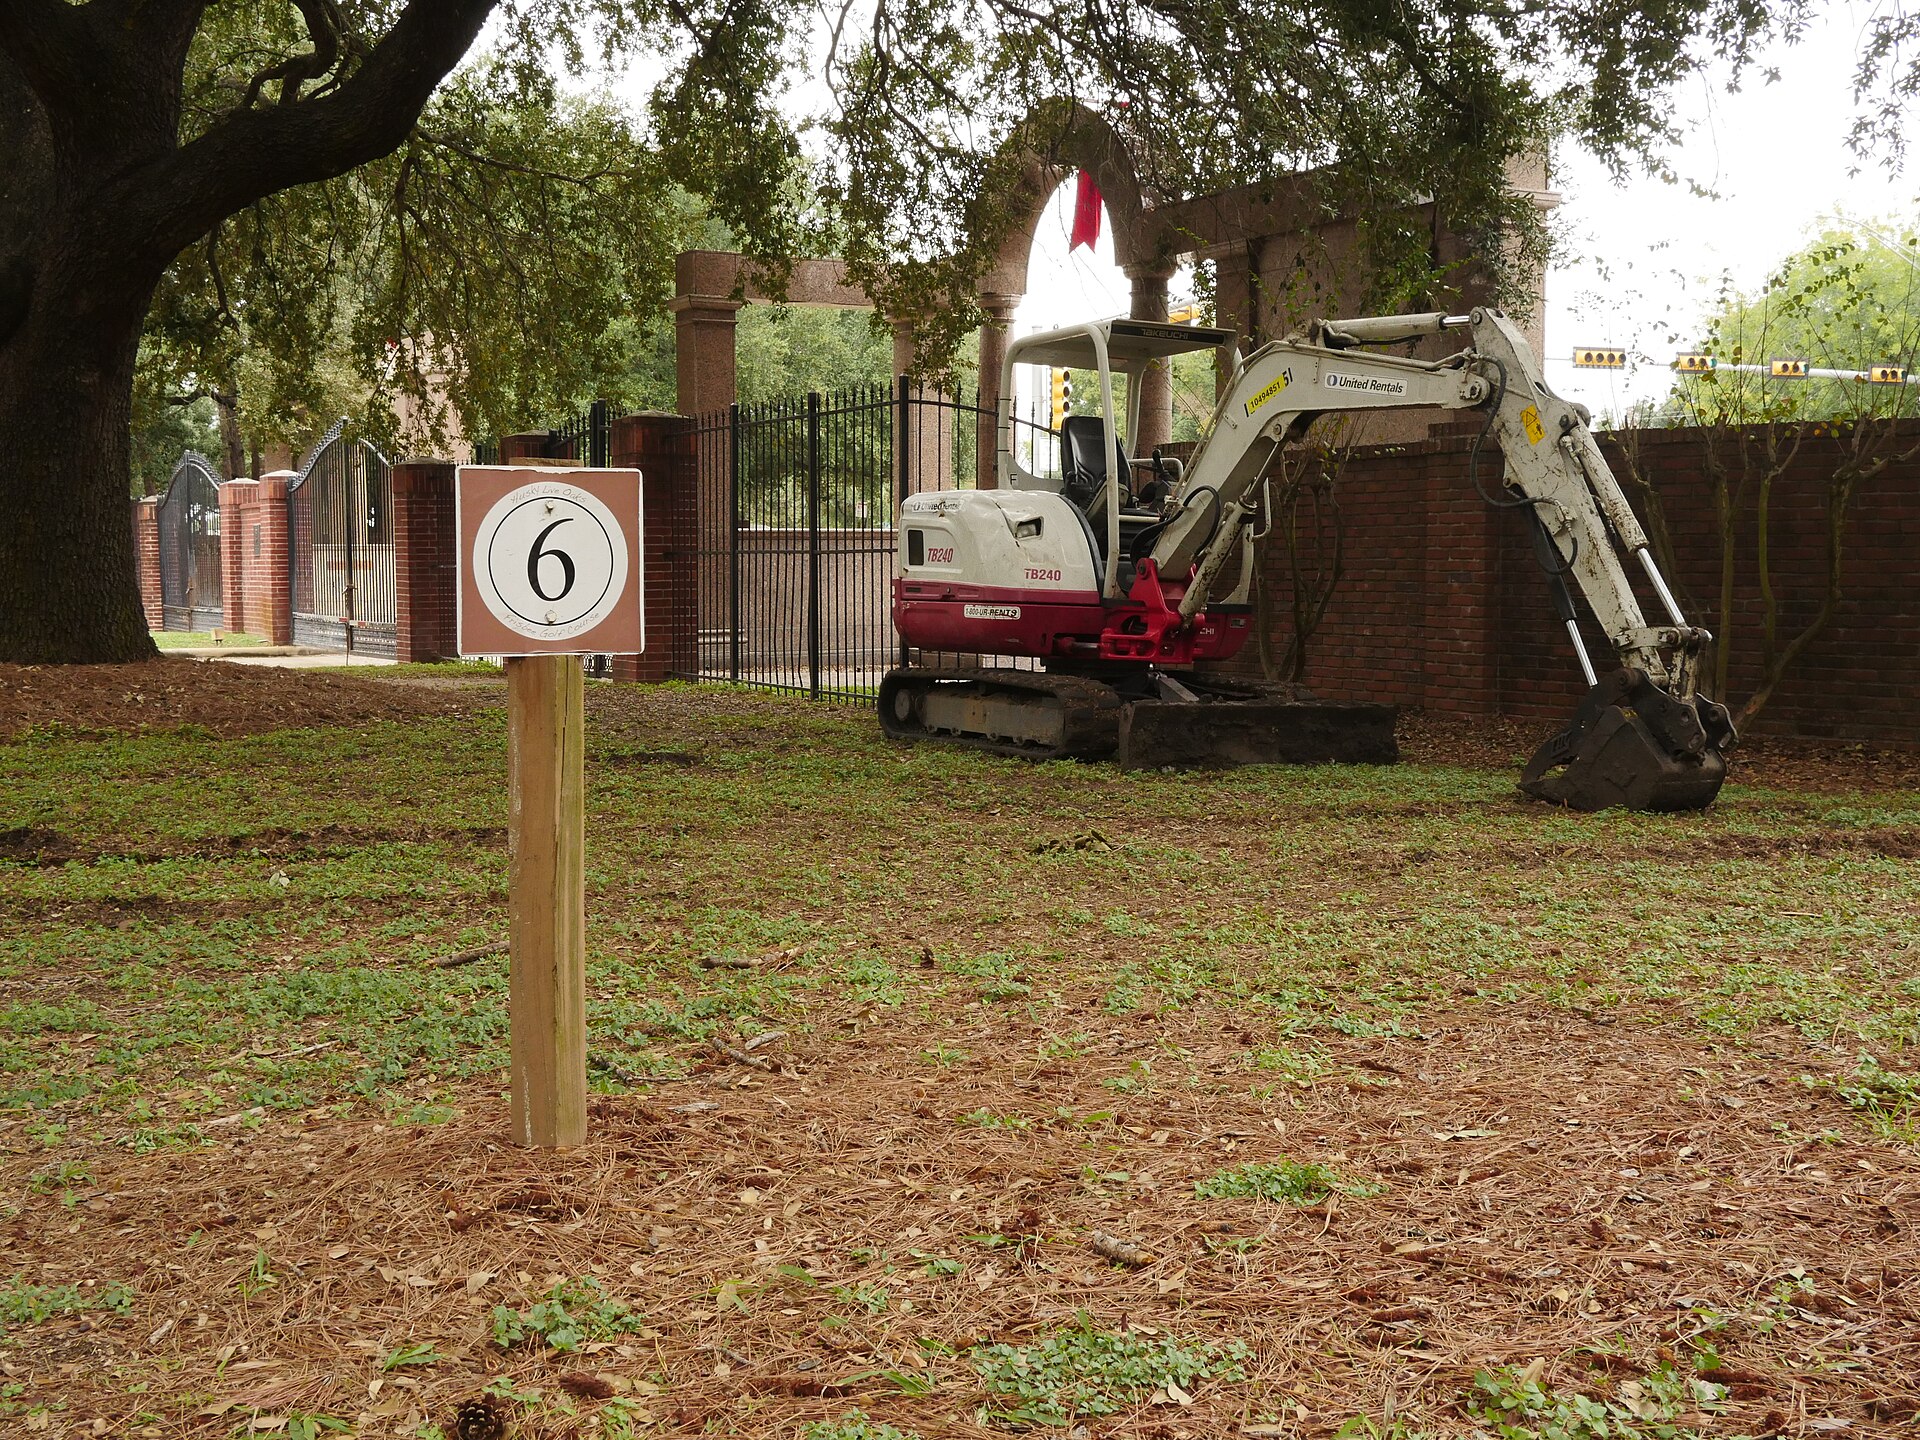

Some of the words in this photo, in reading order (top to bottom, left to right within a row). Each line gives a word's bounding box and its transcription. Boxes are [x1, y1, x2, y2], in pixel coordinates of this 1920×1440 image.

[1339, 376, 1370, 390] United
[1369, 379, 1404, 394] Rentals
[1250, 381, 1281, 408] 10494851
[542, 485, 560, 495] Live
[562, 488, 587, 503] Oaks
[527, 518, 576, 602] 6
[927, 547, 954, 564] TB240
[1024, 568, 1062, 581] TB240
